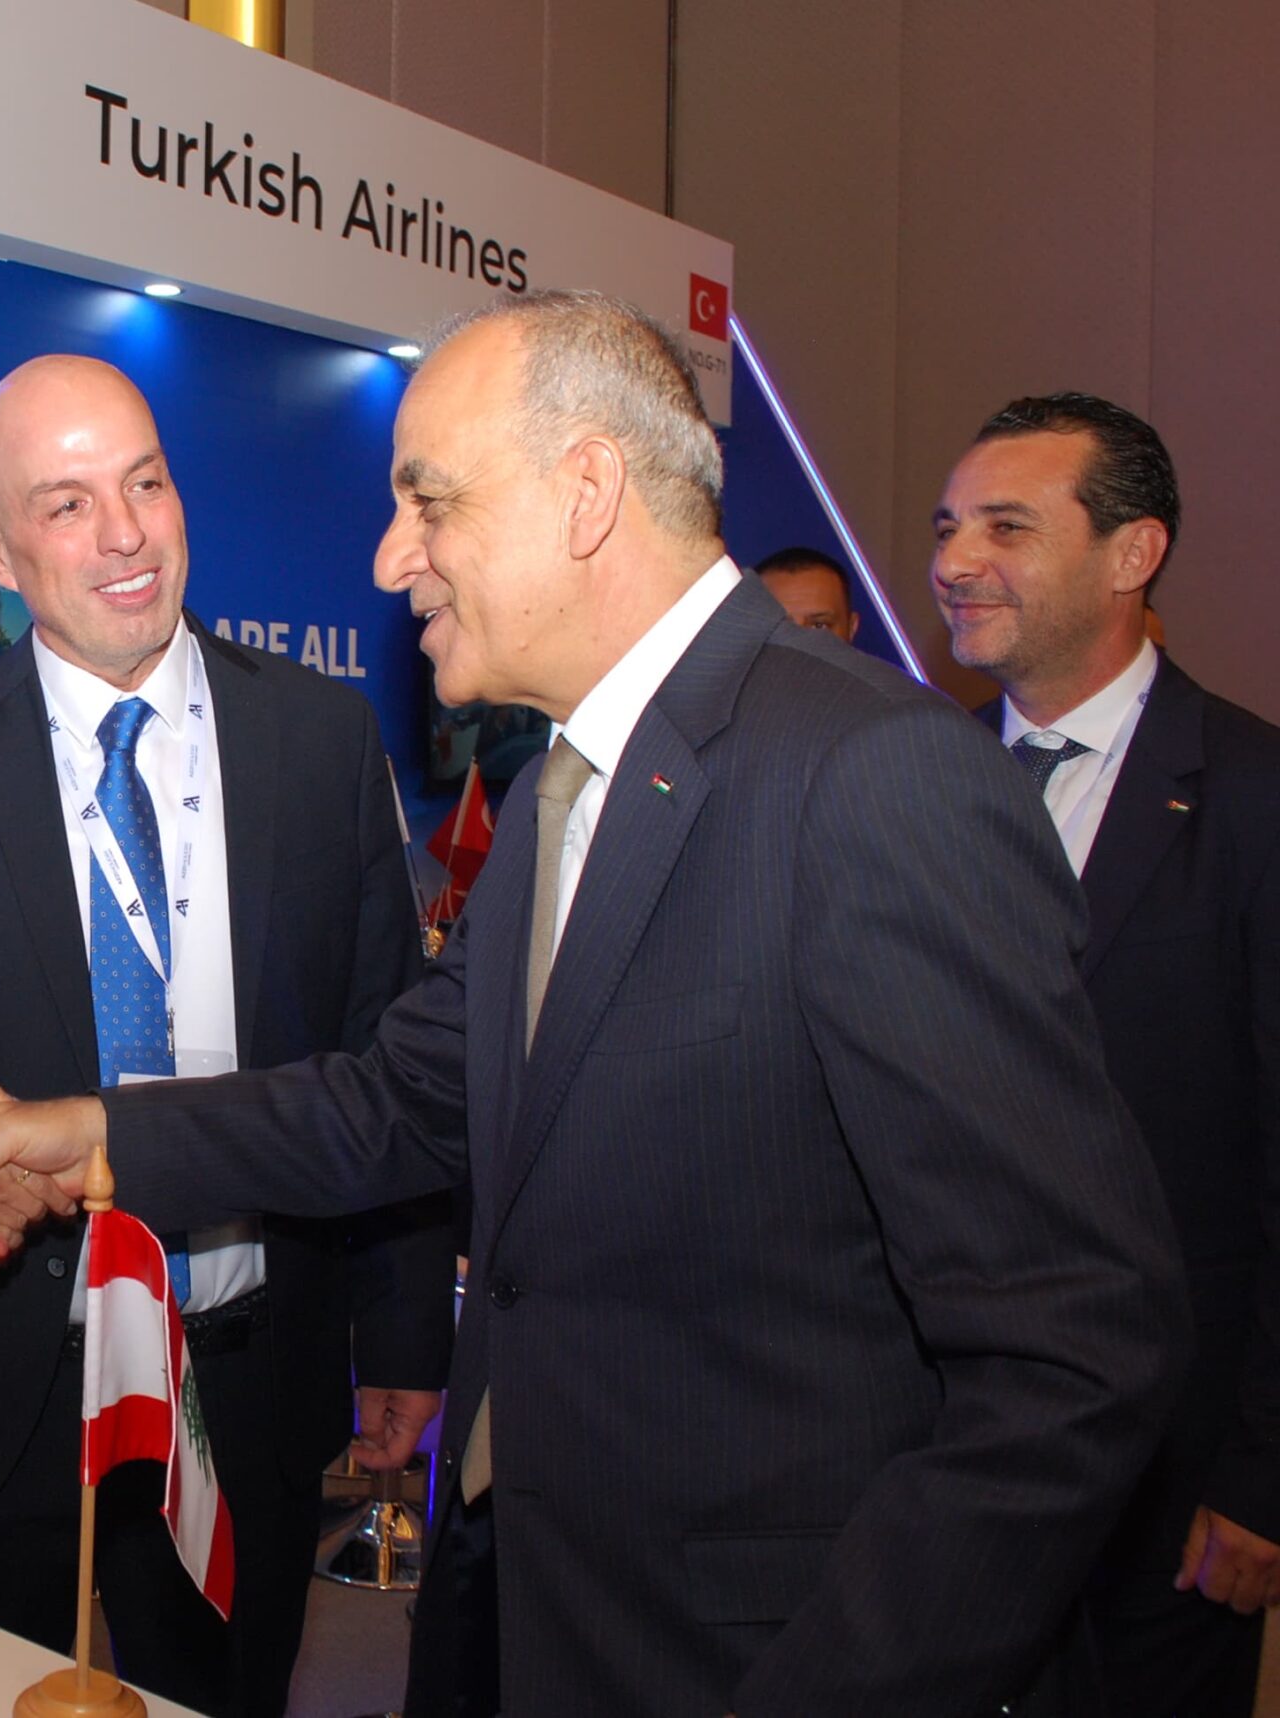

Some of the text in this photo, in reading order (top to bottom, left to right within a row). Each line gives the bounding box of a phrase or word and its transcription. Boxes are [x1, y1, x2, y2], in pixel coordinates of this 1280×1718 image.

[85, 84, 528, 294] Turkish Airlines
[300, 625, 366, 678] ALL
